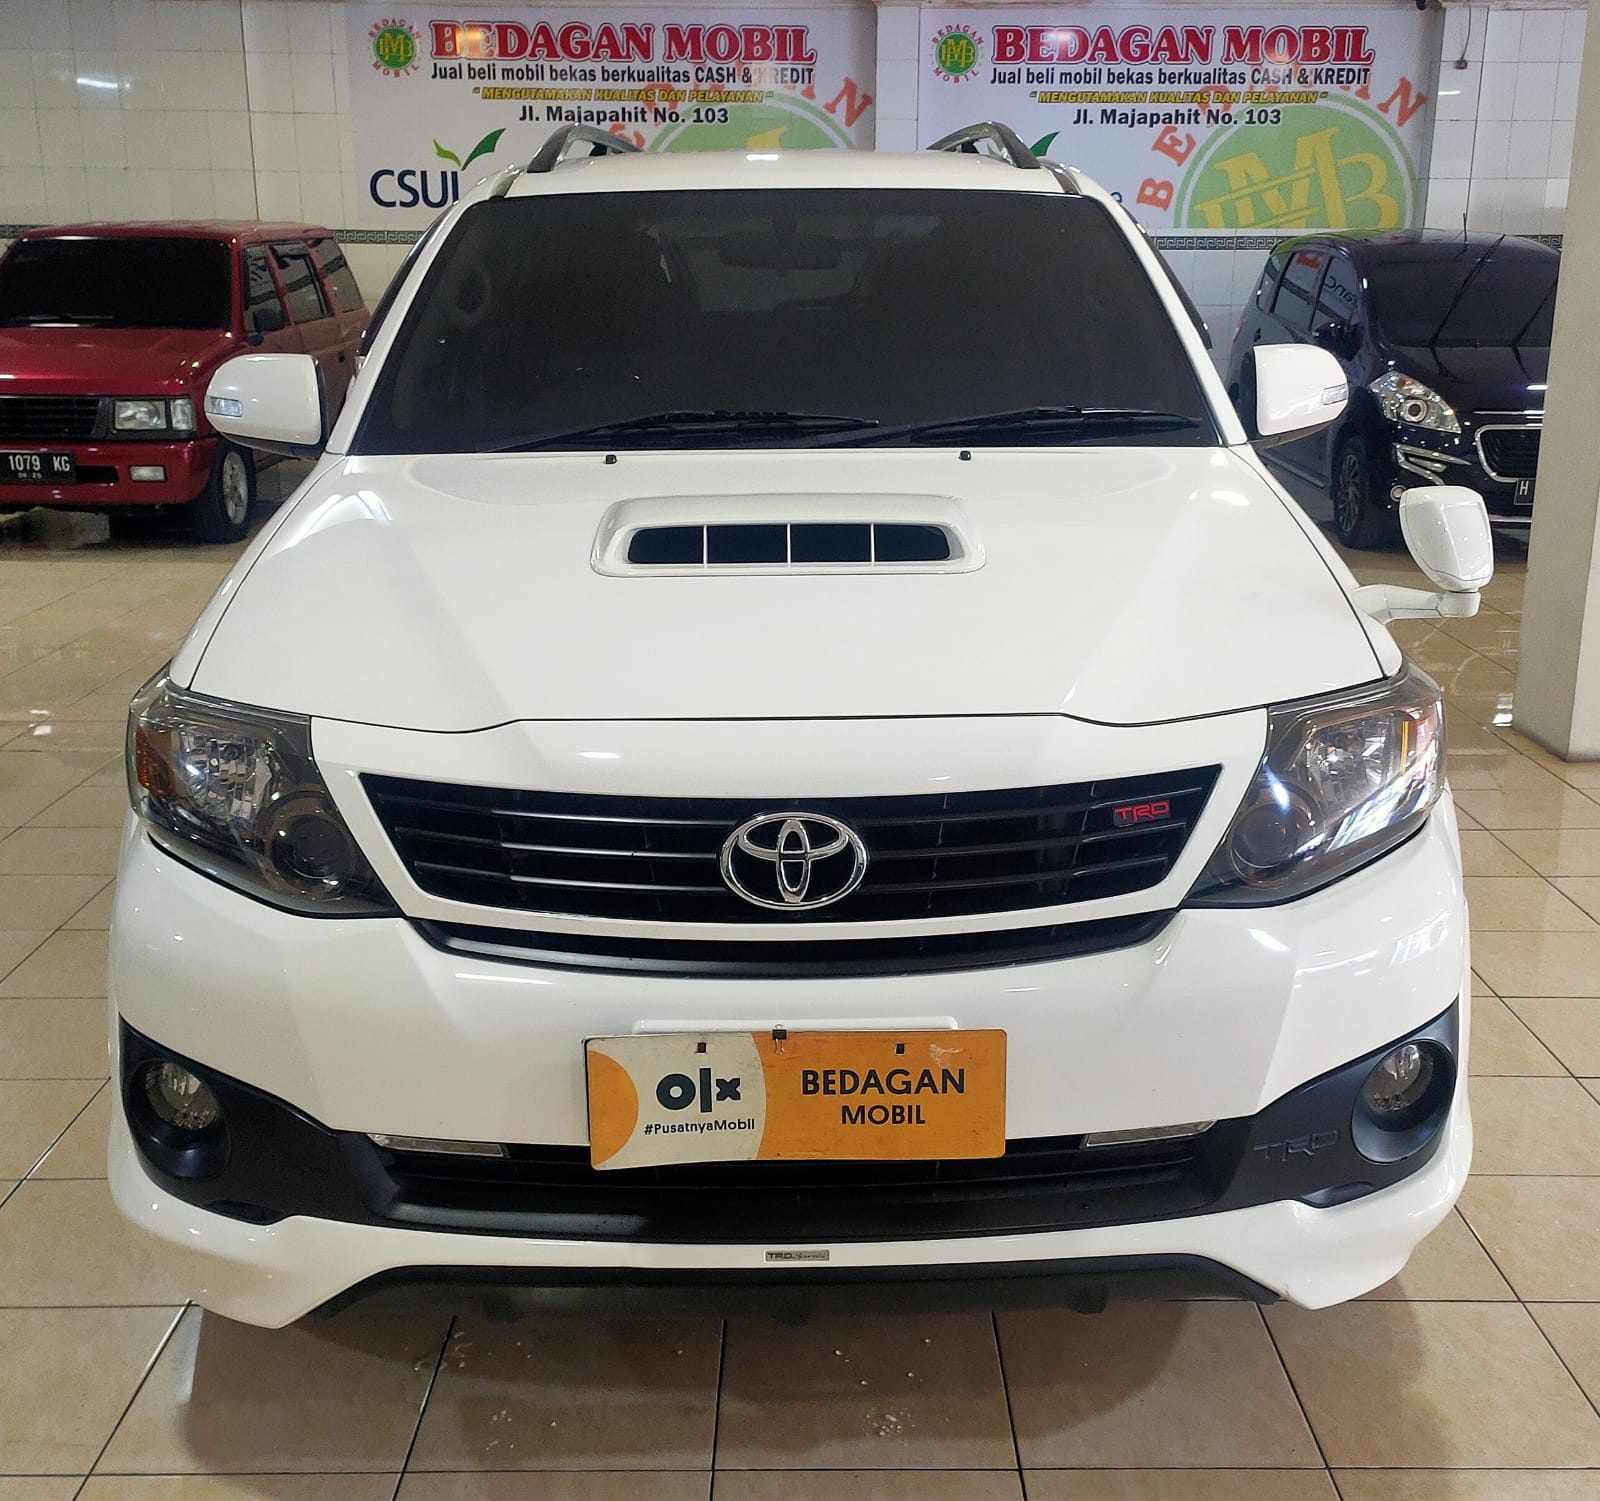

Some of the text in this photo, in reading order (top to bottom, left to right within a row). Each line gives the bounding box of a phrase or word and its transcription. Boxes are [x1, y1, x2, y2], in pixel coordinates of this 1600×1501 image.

[429, 20, 817, 64] BEDAGAN MOBIL
[992, 25, 1376, 65] BEDAGAN MOBIL
[431, 62, 463, 80] Jual
[467, 63, 497, 81] beli
[501, 64, 545, 82] mobil
[550, 65, 597, 82] bekas
[601, 65, 691, 83] berkualitas
[694, 66, 737, 84] CASH
[741, 67, 753, 84] &
[990, 67, 1371, 85] Jual beli mobil bekas berkualitas CASH & KREDIT
[481, 87, 593, 101] MENGUTAMAKAN
[593, 89, 656, 102] KUALITAS
[657, 91, 687, 102] DAN
[688, 91, 764, 103] PELAYANAN
[1038, 91, 1148, 103] MENGUTAMAKAN
[1148, 91, 1211, 103] KUALITAS
[1212, 92, 1241, 103] DAN
[1242, 92, 1319, 103] PELAYANAN
[519, 105, 729, 125] Jl. Majapahit No. 103
[1073, 109, 1281, 128] Jl. Majapahit No. 103
[8, 454, 71, 472] 1079 KG
[1519, 480, 1529, 496] H
[1114, 801, 1169, 824] TRD
[656, 1068, 741, 1113] olx
[801, 1068, 966, 1096] BEDAGAN
[841, 1104, 926, 1125] MOBIL
[643, 1118, 756, 1137] #PusatnyaMobil
[1253, 1130, 1338, 1162] TRD
